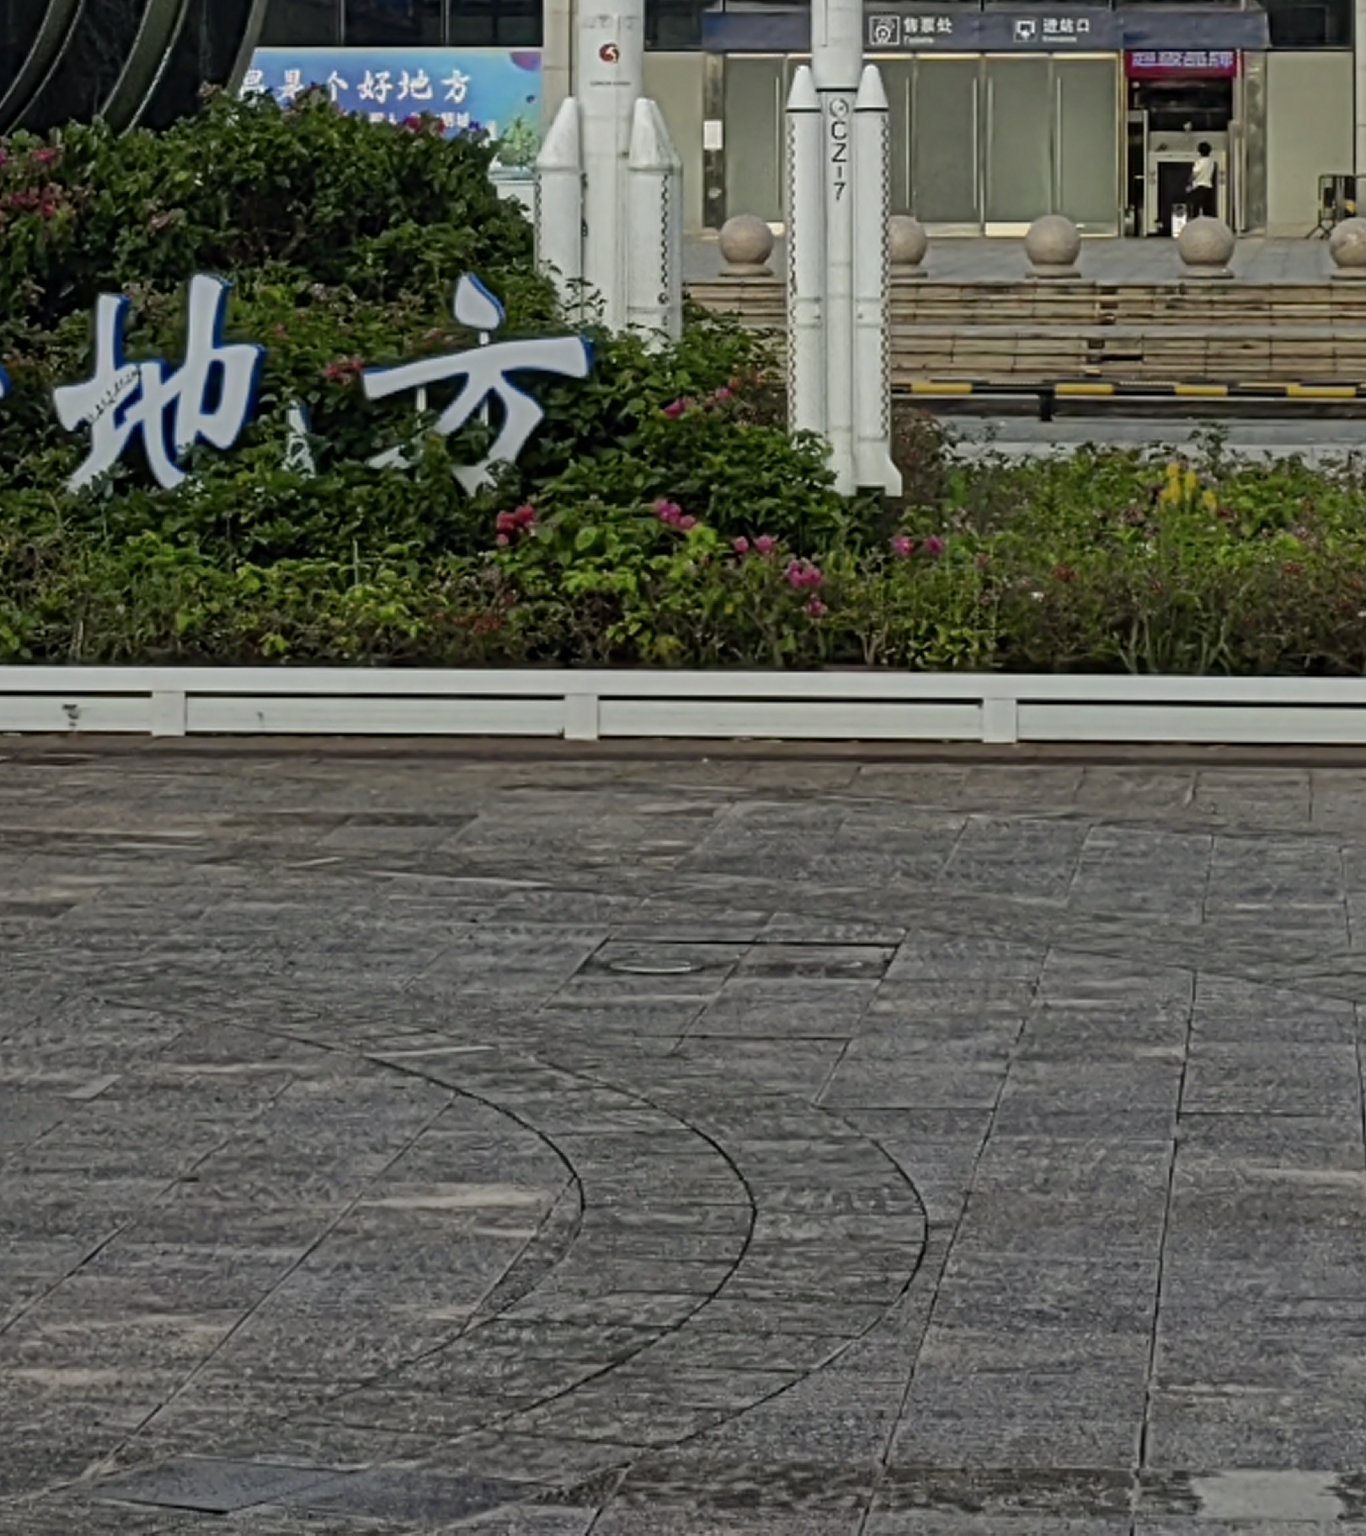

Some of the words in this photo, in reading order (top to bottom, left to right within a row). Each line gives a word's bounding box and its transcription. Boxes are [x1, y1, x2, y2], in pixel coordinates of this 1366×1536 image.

[903, 16, 953, 34] 售票处
[1042, 17, 1091, 34] 进站口
